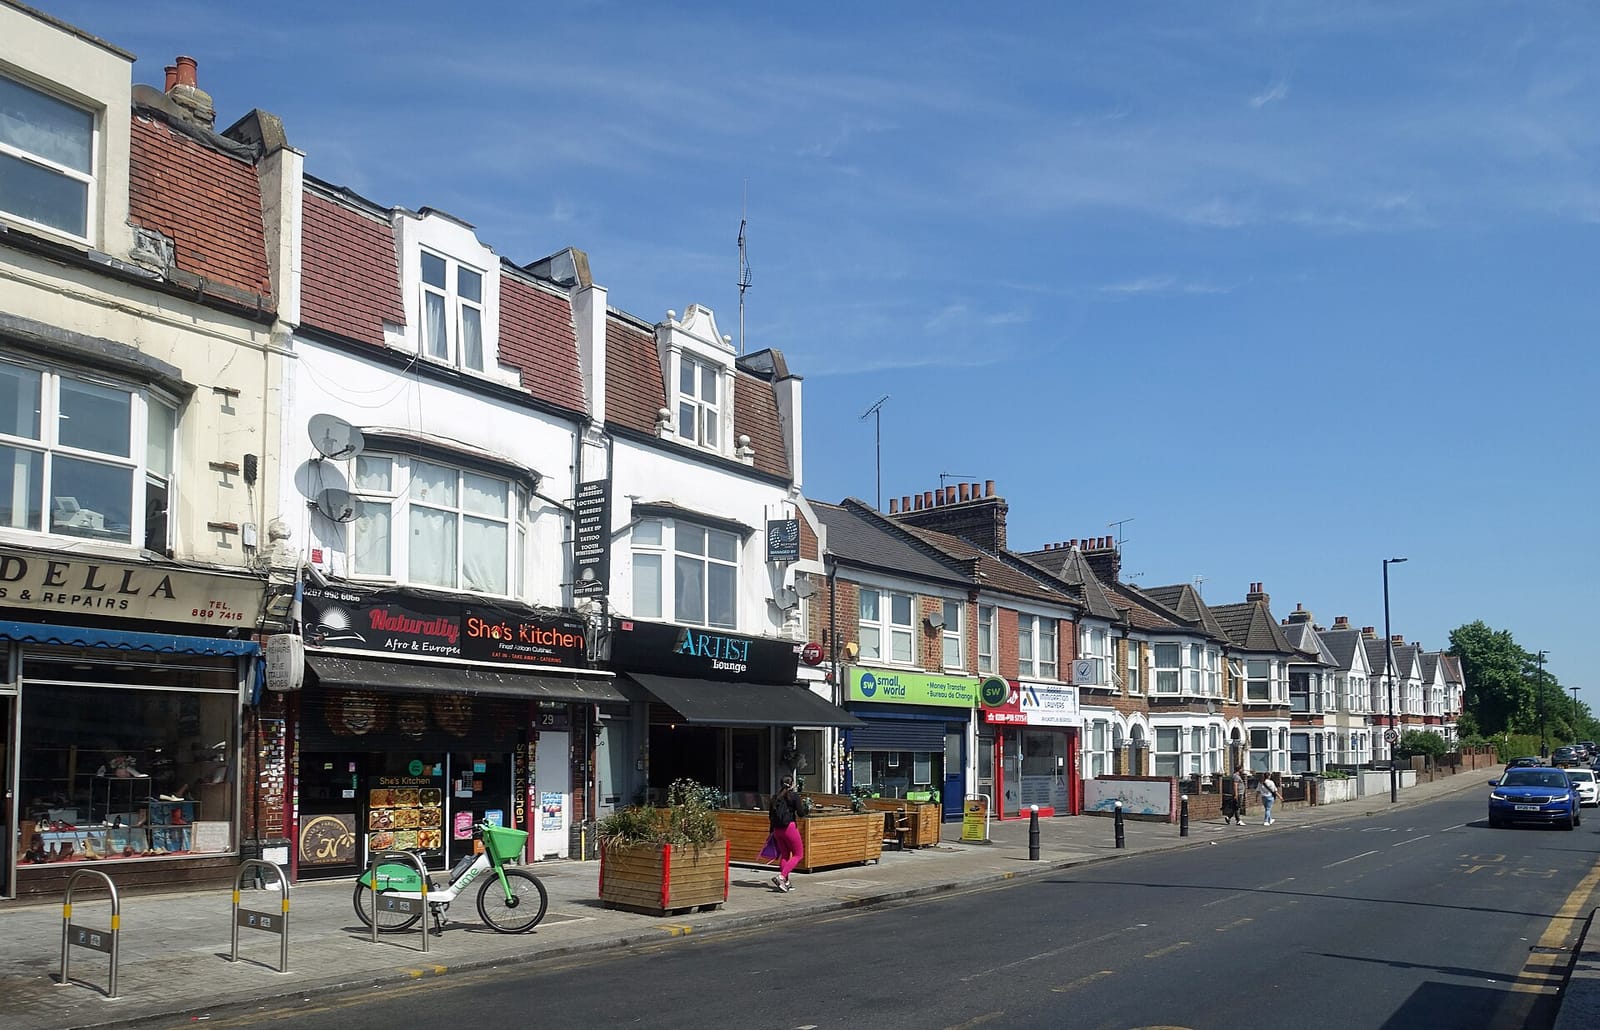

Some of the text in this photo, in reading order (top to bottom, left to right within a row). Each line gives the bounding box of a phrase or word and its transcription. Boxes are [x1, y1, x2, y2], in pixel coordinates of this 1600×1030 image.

[576, 497, 605, 506] LOCTICIAN
[580, 534, 600, 542] TATTOO
[20, 589, 31, 600] &
[43, 592, 129, 610] REPAIRS
[209, 600, 231, 610] TEL.
[191, 608, 243, 621] 889 7415
[369, 608, 460, 644] Naturally
[519, 622, 584, 650] Kitchen
[384, 638, 409, 651] Afro
[411, 640, 420, 650] &
[673, 627, 753, 662] ARTIST
[540, 656, 562, 664] CATERING
[711, 658, 747, 674] Lounge
[269, 679, 289, 688] SHOES
[877, 675, 900, 686] small
[883, 685, 906, 696] world
[929, 682, 967, 691] Money Transfer
[929, 690, 948, 699] Bureau
[955, 692, 974, 701] Change
[541, 714, 554, 725] 29
[1385, 732, 1396, 740] 20
[401, 777, 431, 785] Kitchen
[516, 778, 525, 823] Kitchen
